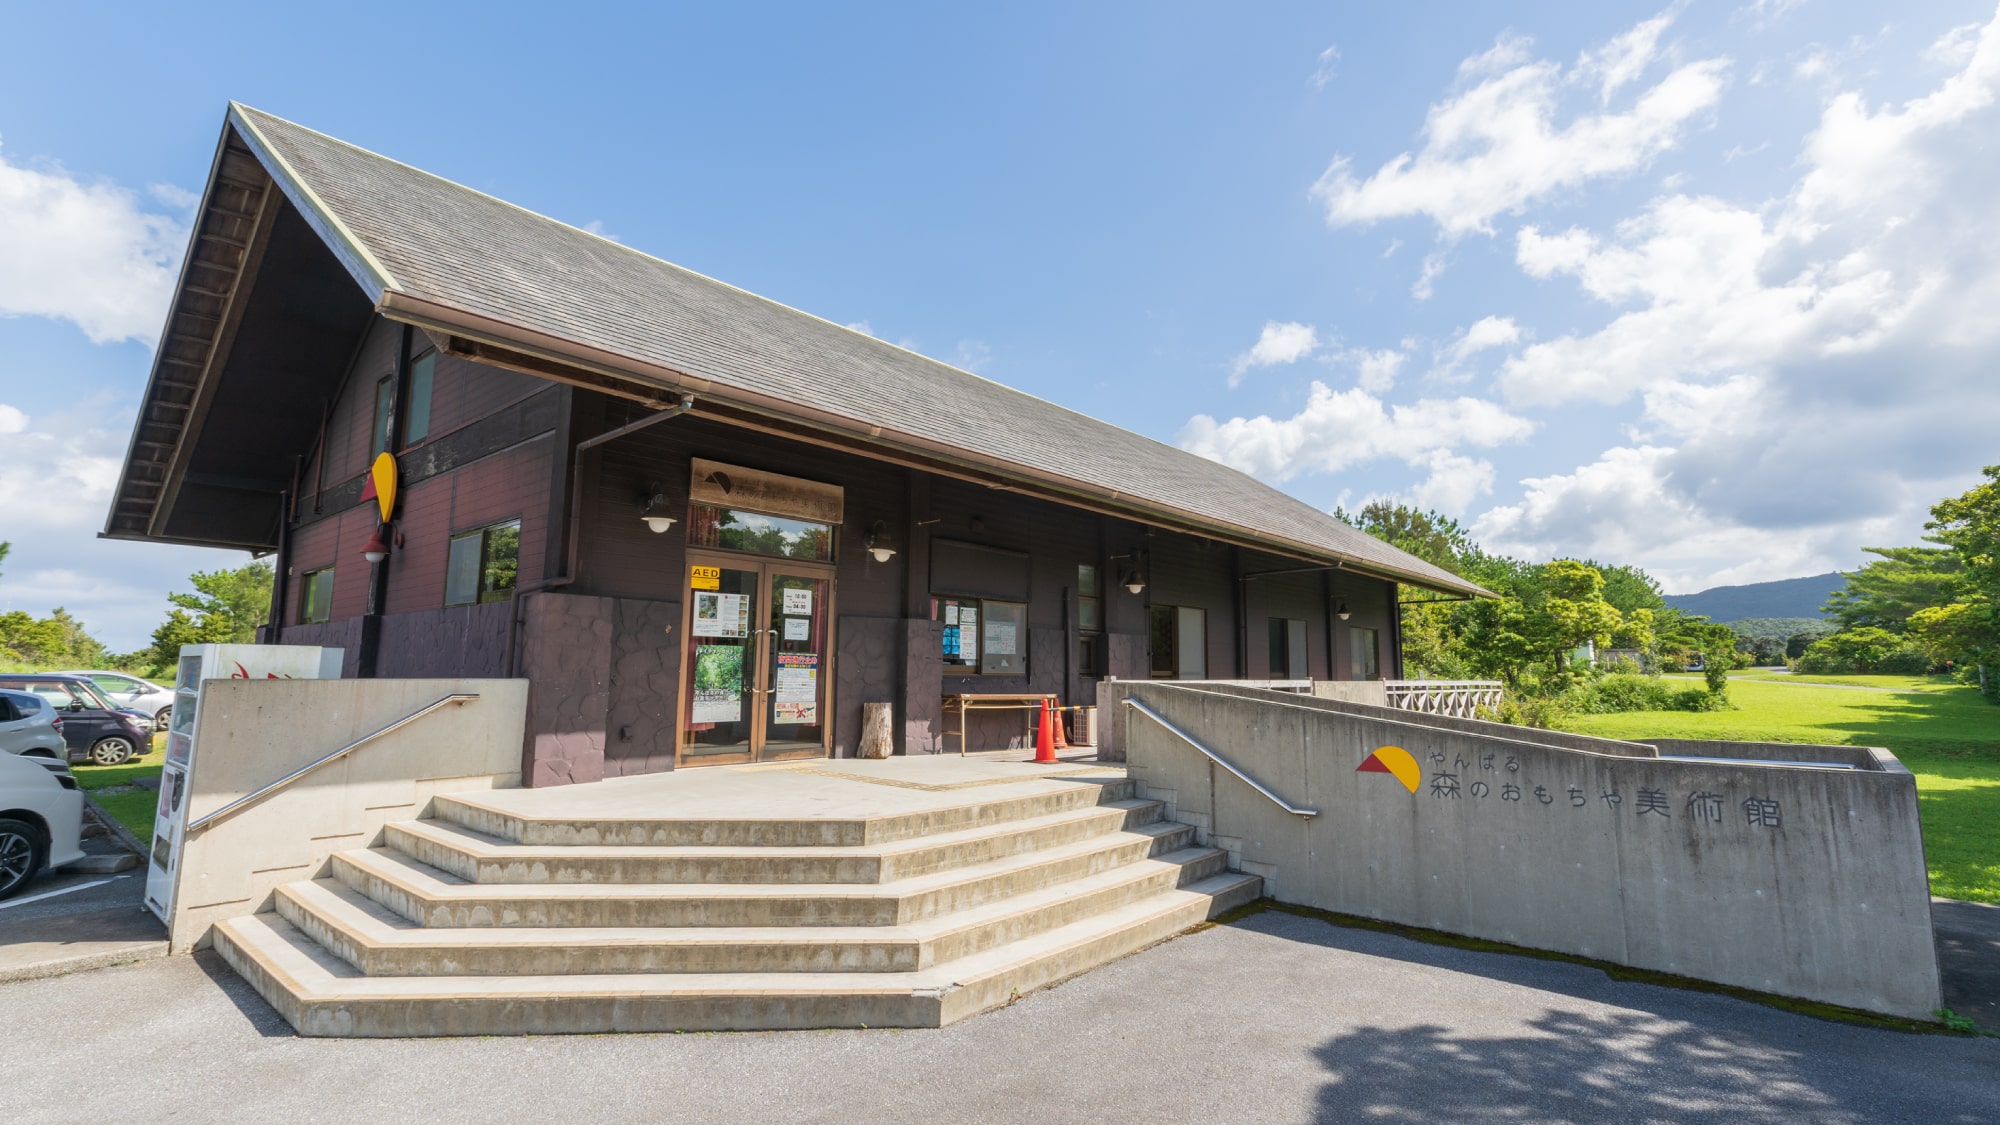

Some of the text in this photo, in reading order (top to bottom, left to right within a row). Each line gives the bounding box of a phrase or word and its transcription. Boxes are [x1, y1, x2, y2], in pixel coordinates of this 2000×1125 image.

[693, 568, 718, 578] AED
[1430, 752, 1519, 772] やんばる
[1430, 770, 1781, 828] 森のおもちゃ美術館
